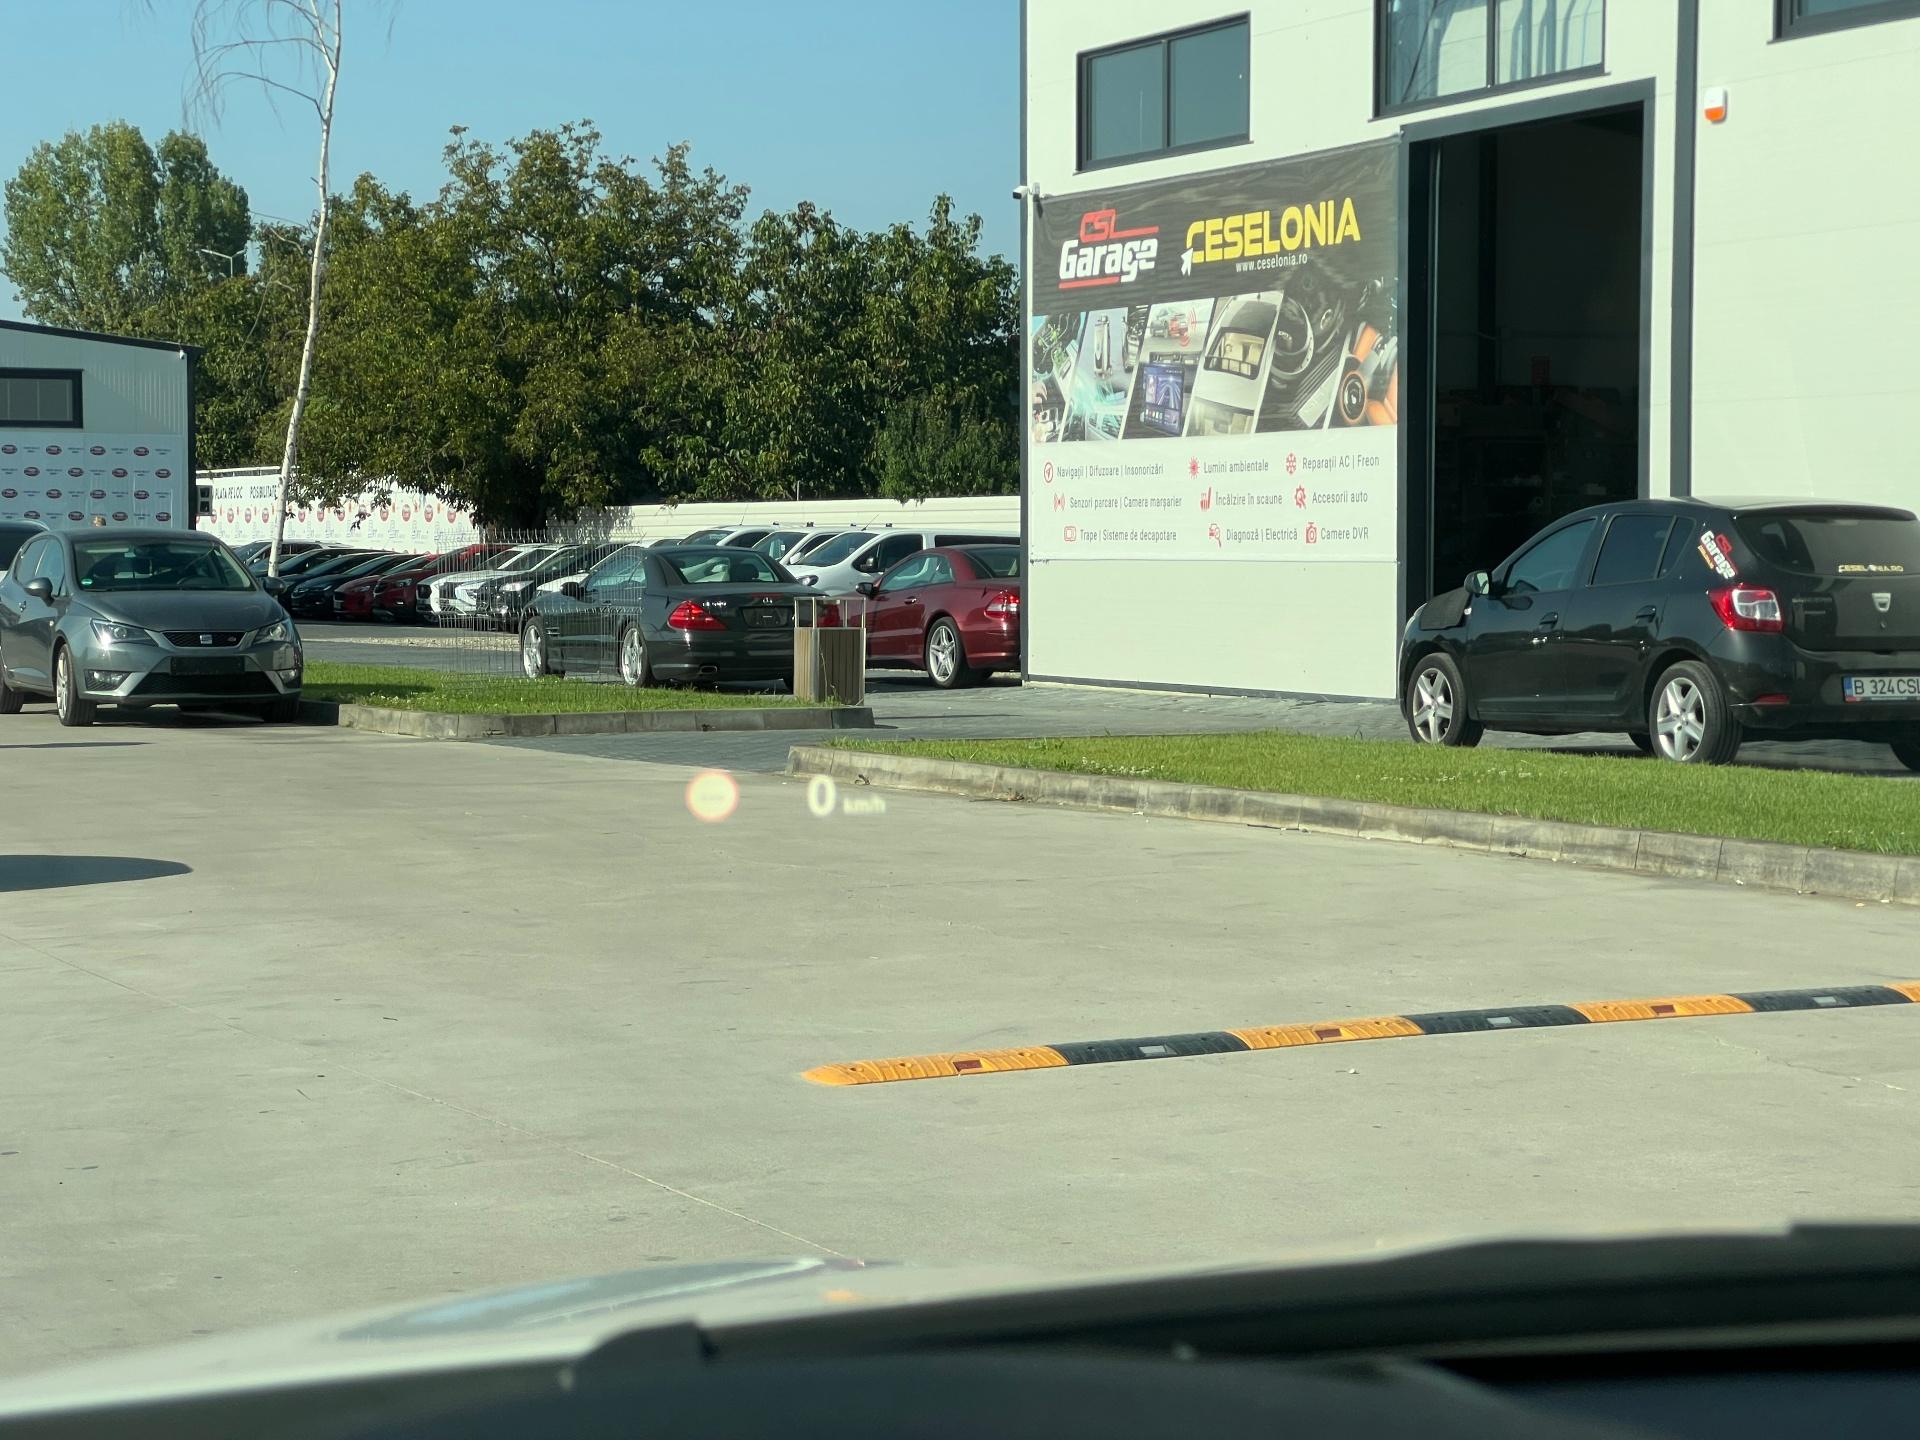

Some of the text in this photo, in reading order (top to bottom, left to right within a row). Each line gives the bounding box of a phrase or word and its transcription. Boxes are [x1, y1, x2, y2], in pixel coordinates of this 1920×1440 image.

[1186, 197, 1361, 264] CESELONIA
[1060, 238, 1158, 283] Garage
[1235, 253, 1308, 272] www.ceselonia.ro
[1204, 458, 1269, 473] Lumini ambientale
[1339, 455, 1350, 468] AC
[1357, 454, 1380, 467] Freon
[1089, 464, 1120, 476] Difuzoare
[1069, 496, 1093, 509] Senzori
[1094, 498, 1119, 511] parcare
[1256, 494, 1283, 505] scaune
[1312, 490, 1369, 504] Accesorii auto
[1079, 529, 1177, 543] Trape Sisteme de decapotare
[1320, 526, 1369, 540] Camere DVR
[1700, 530, 1736, 579] Garage
[1855, 679, 1865, 695] B
[1870, 679, 1895, 695] 324
[807, 774, 837, 817] 0
